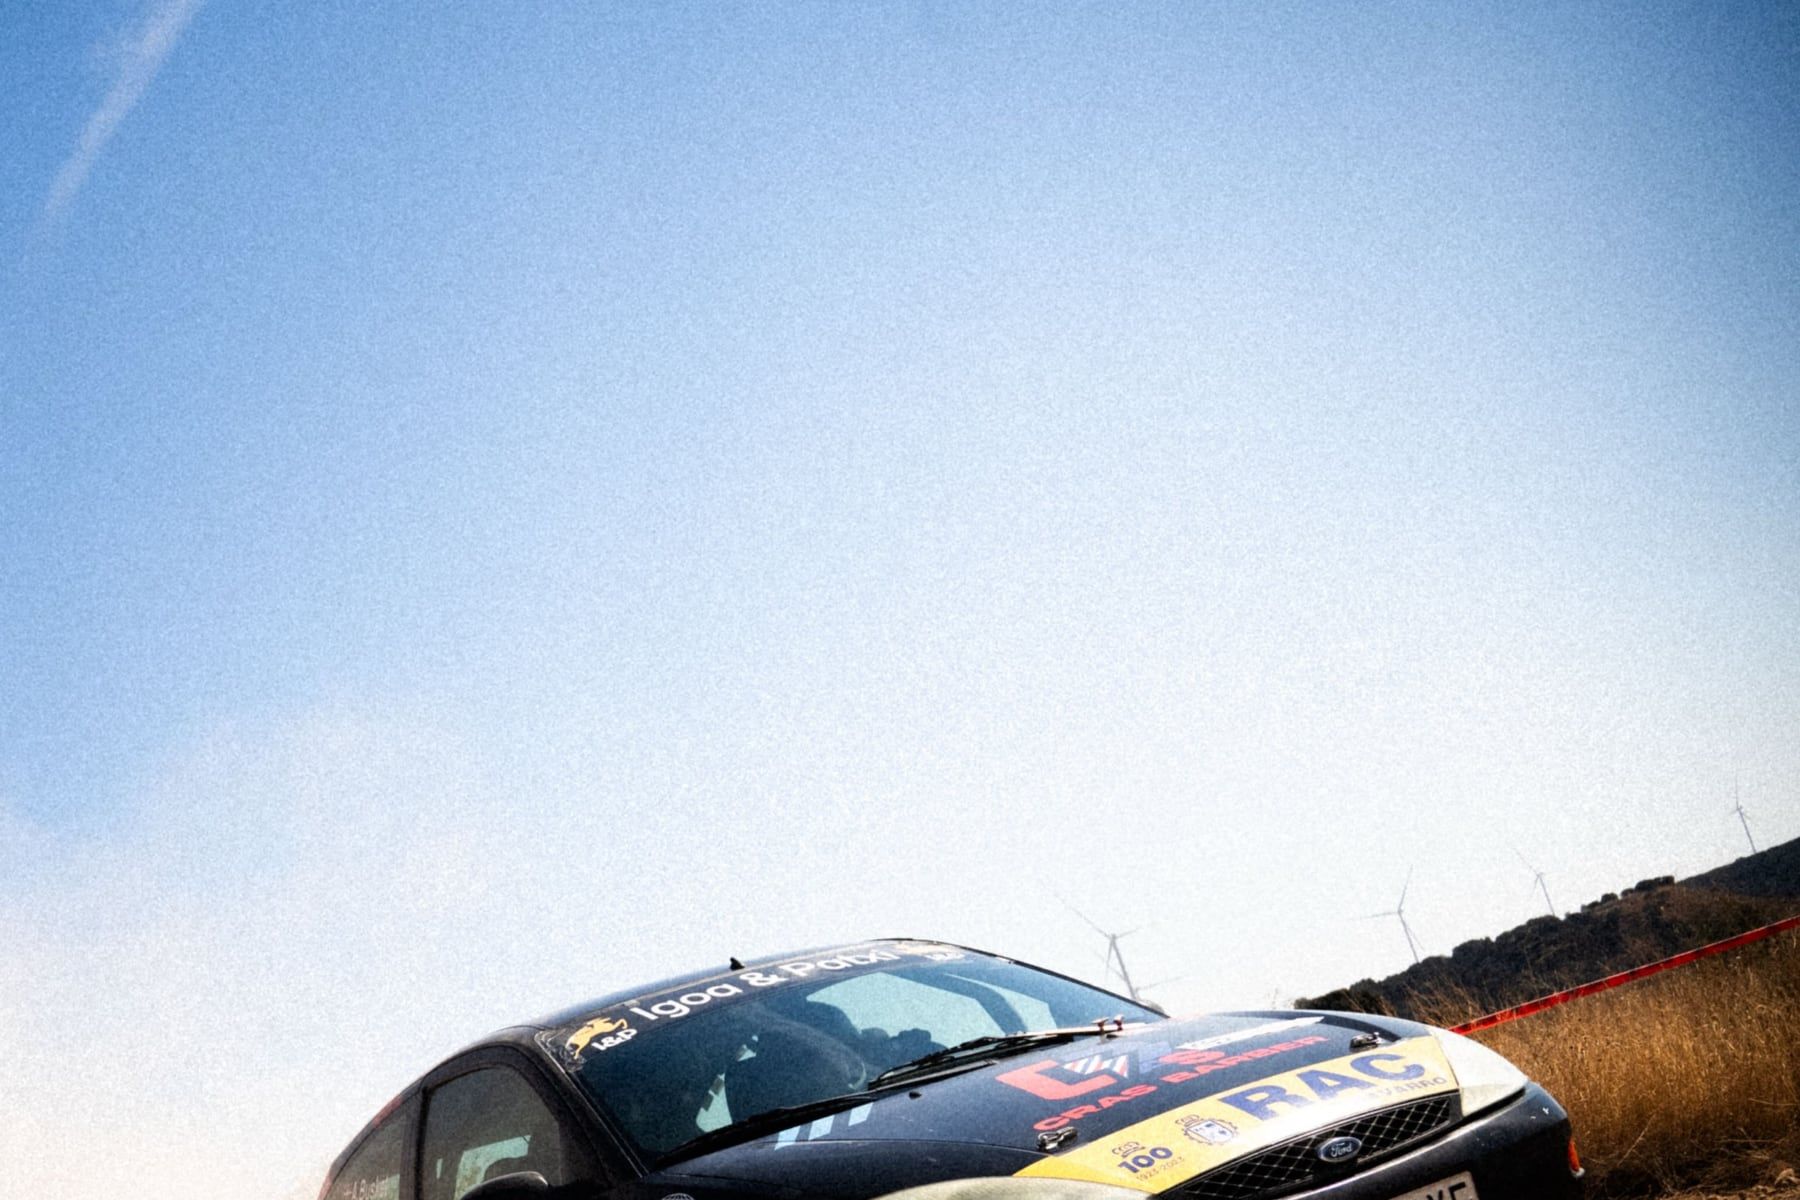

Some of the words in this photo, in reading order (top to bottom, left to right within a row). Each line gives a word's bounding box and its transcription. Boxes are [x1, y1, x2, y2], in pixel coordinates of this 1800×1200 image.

[629, 982, 744, 1021] Igoa
[739, 972, 789, 987] &
[591, 1027, 639, 1051] I&P
[1033, 1083, 1159, 1131] CRAS
[1159, 1035, 1330, 1083] BARBER
[1217, 1053, 1426, 1122] RAC
[1117, 1146, 1174, 1174] 100
[1330, 1142, 1353, 1158] Ford
